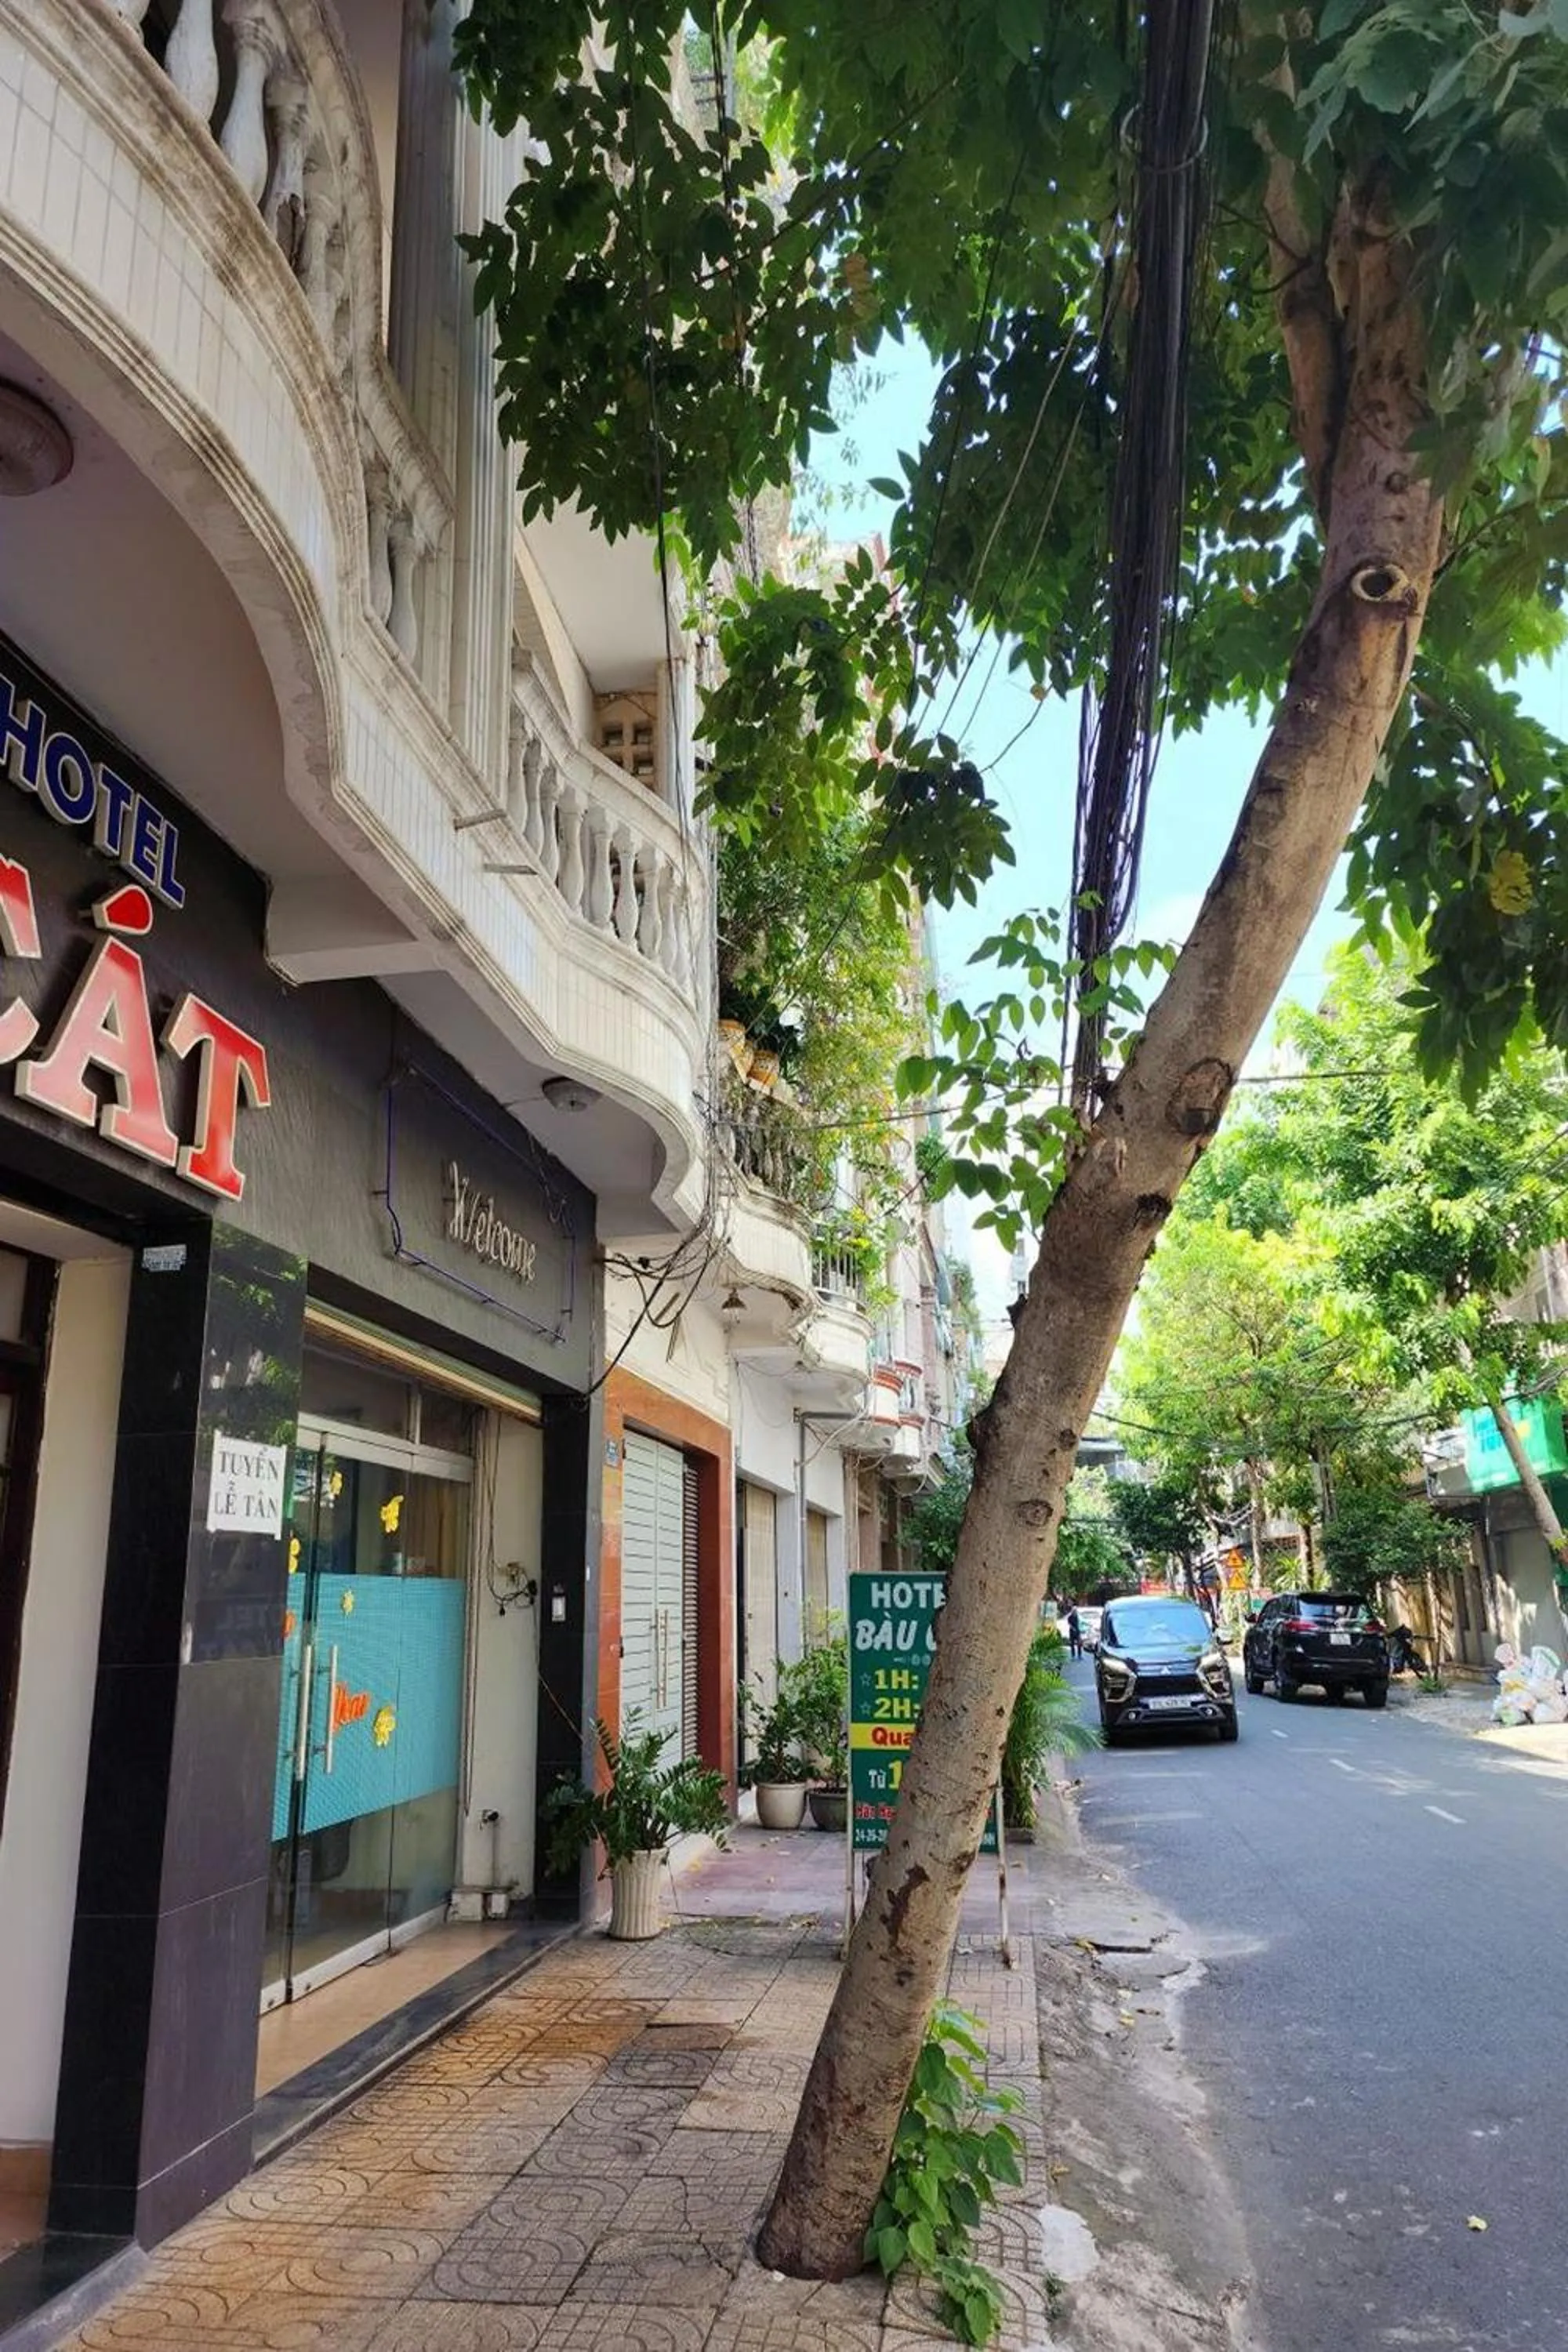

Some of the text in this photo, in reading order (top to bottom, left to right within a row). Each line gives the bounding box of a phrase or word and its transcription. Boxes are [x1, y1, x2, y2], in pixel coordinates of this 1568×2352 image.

[0, 673, 186, 909] HOTEL
[448, 1160, 537, 1286] Welcome
[220, 1446, 278, 1480] TUYỂN
[244, 1490, 279, 1519] TÂN
[871, 1581, 947, 1609] HOTE
[873, 1668, 920, 1690] 1H:
